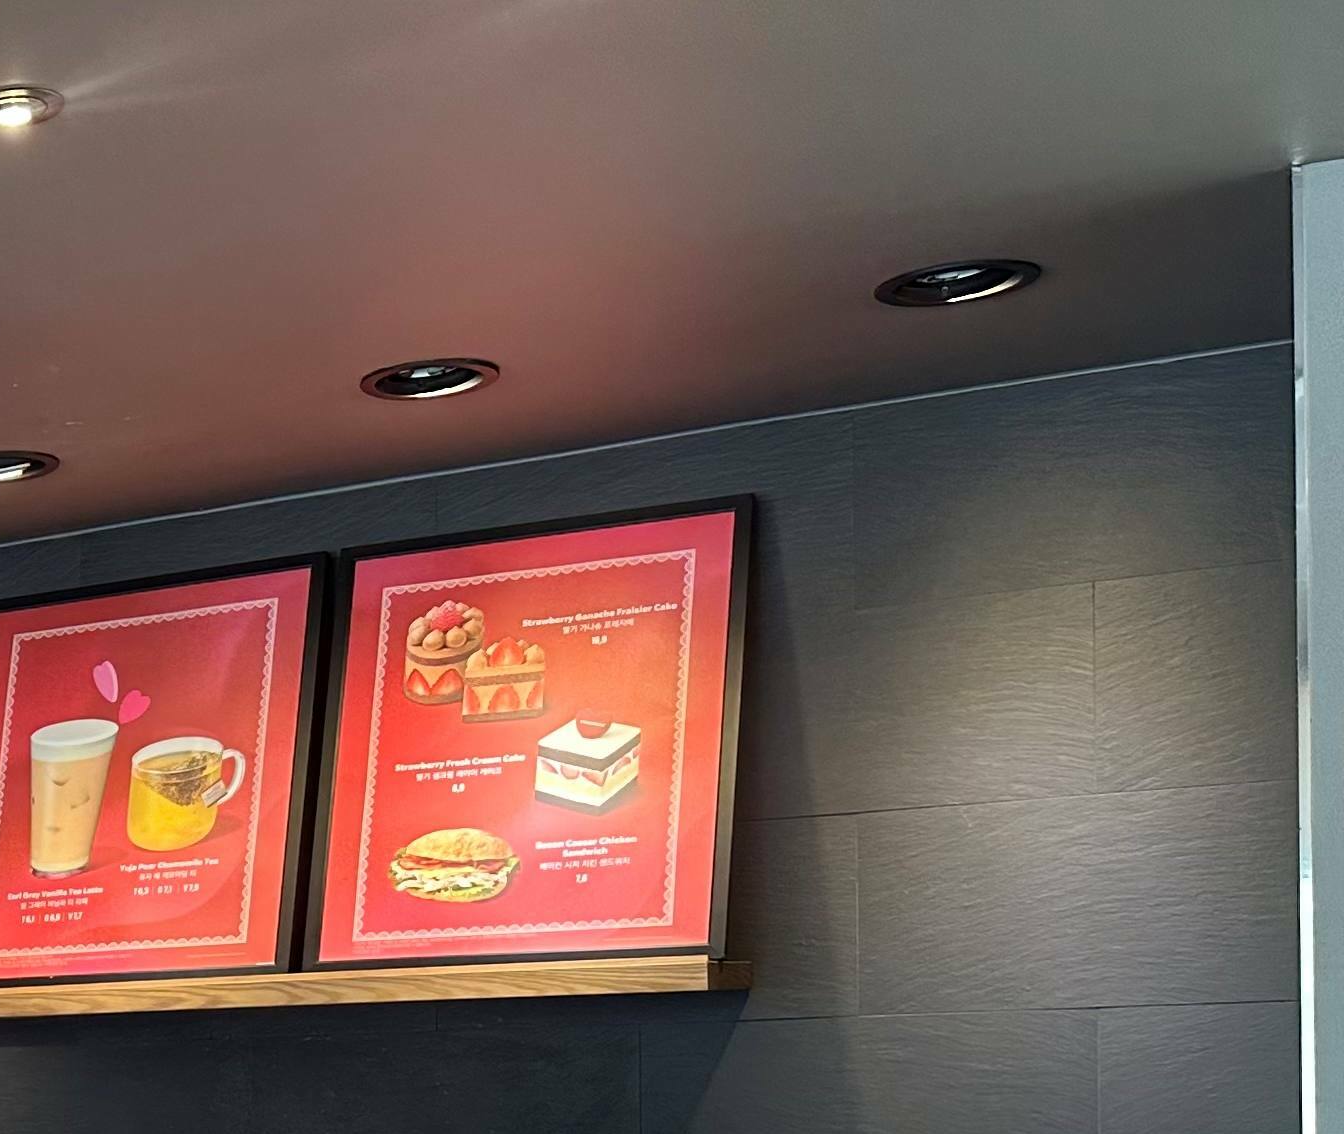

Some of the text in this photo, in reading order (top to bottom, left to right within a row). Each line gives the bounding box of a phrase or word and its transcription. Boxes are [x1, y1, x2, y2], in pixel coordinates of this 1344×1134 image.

[522, 614, 574, 628] Strawberry
[654, 602, 678, 612] Cake
[395, 761, 445, 772] Strawberry
